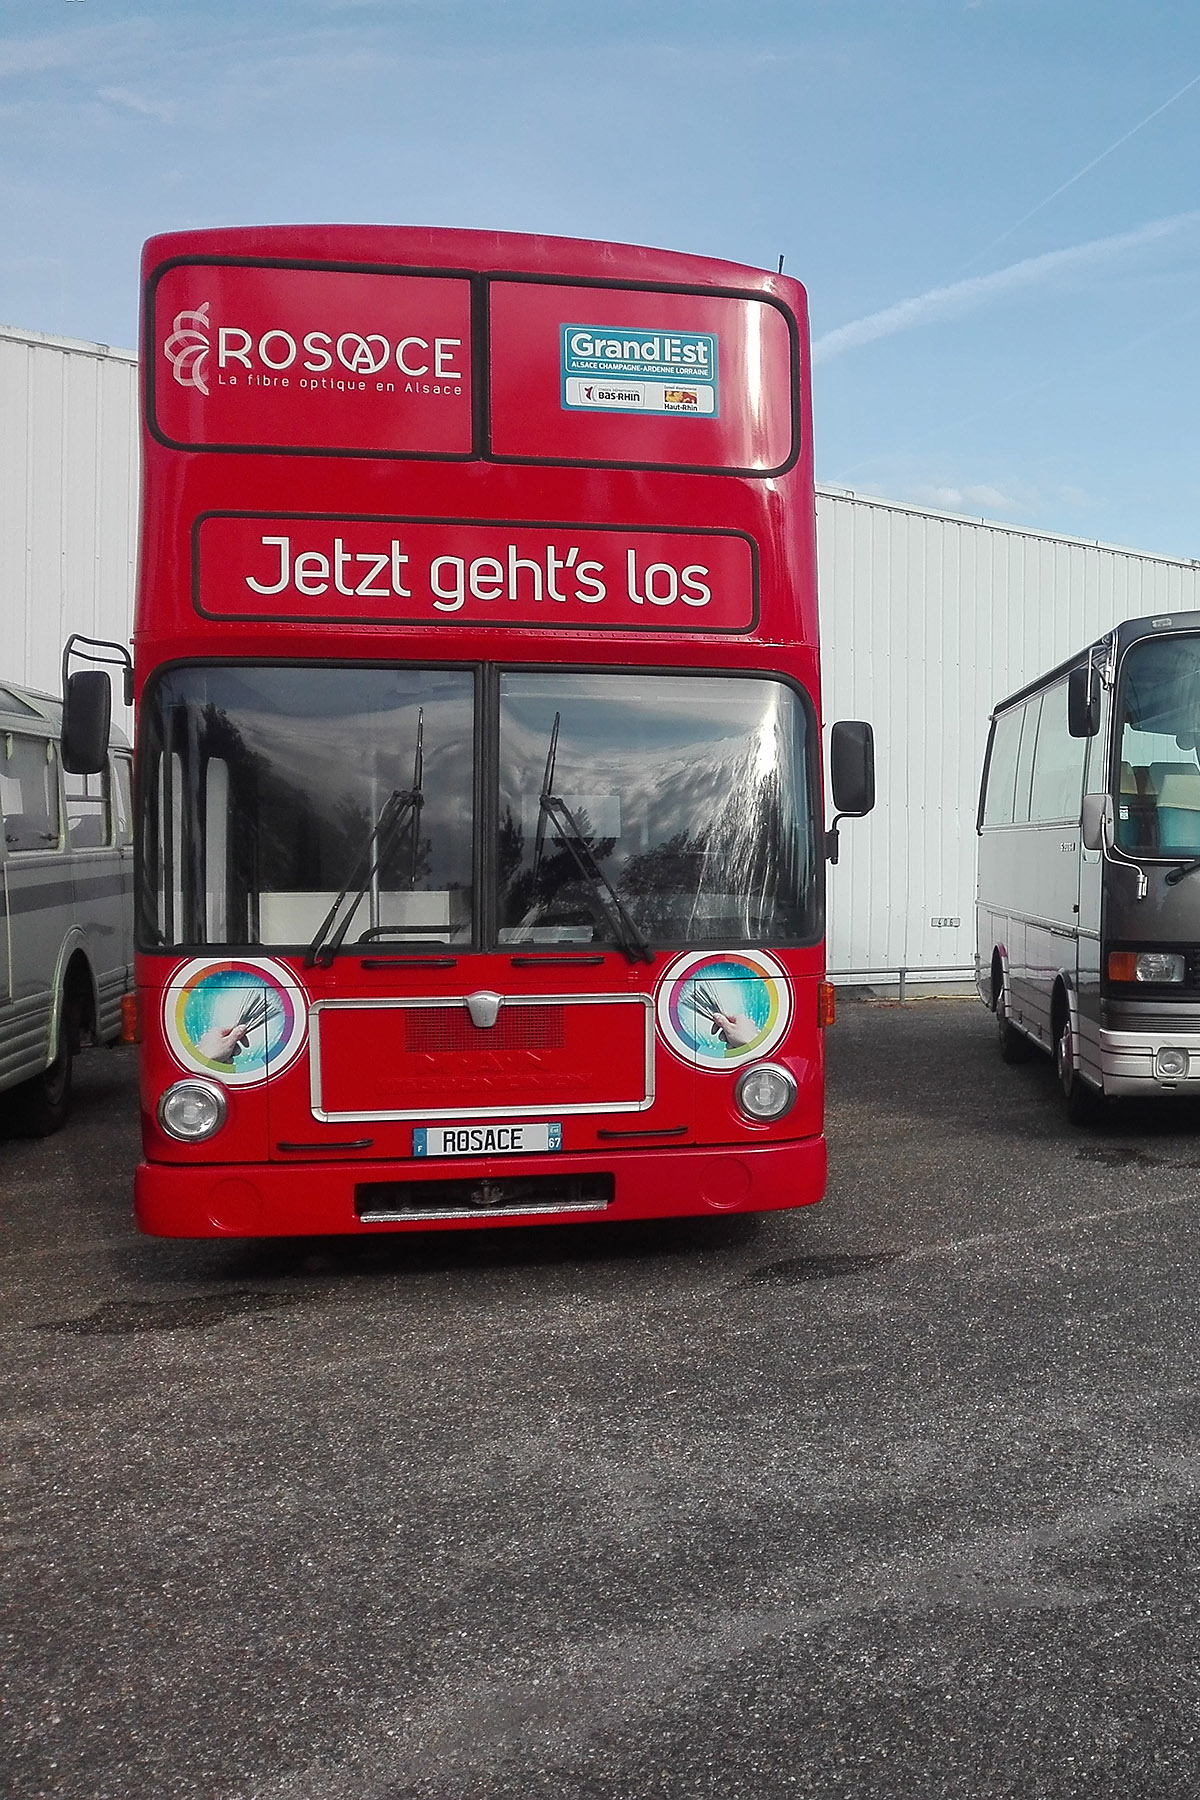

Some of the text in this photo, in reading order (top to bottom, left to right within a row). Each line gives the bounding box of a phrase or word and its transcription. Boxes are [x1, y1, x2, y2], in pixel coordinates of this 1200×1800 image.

[571, 360, 598, 369] ALSACE
[675, 367, 709, 376] LORRAINE
[218, 374, 463, 395] La fibre optique en Alsace
[664, 403, 698, 412] Haut-Rhin
[245, 536, 412, 597] Jetzt
[627, 549, 712, 607] los
[443, 1128, 524, 1152] ROSACE
[548, 1137, 561, 1148] 67
